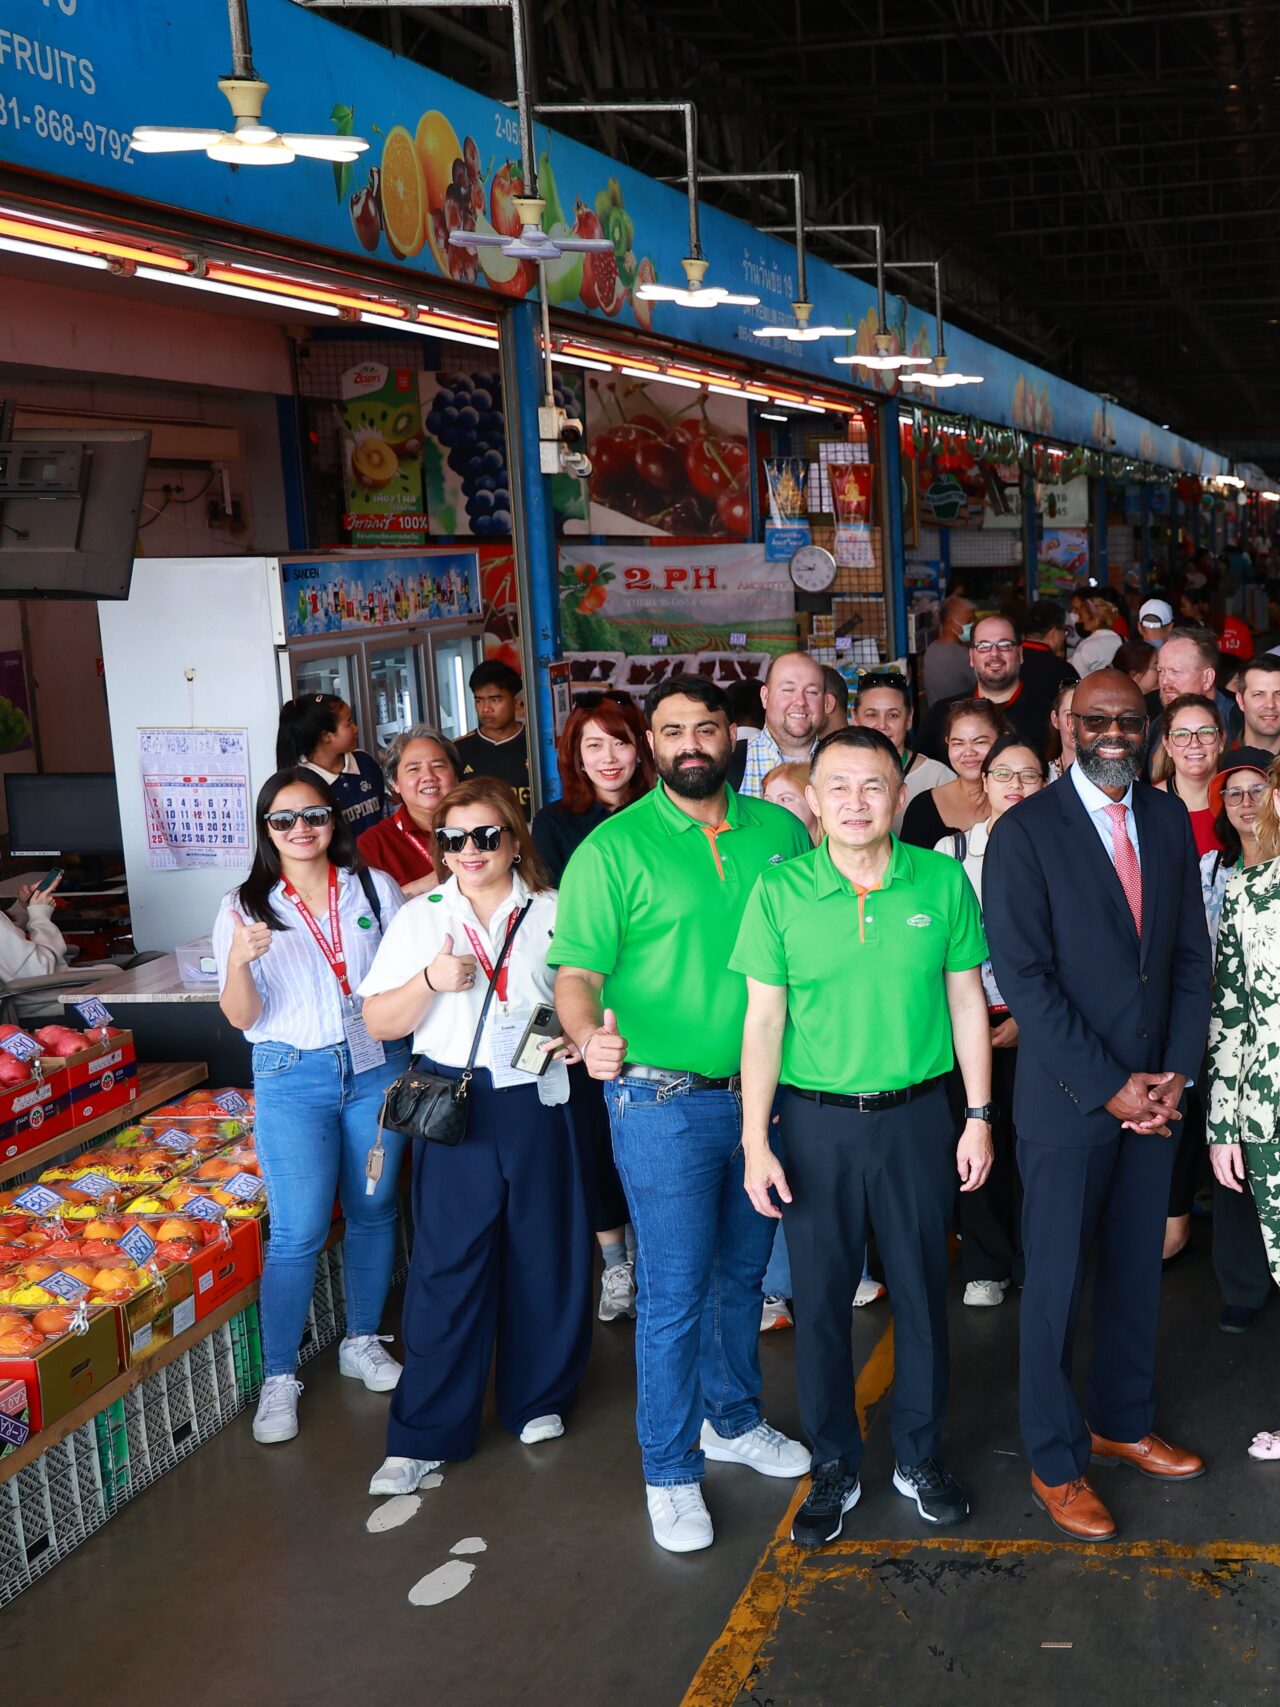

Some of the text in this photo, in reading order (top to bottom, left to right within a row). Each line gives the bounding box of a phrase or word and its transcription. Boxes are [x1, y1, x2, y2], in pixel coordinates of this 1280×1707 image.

[0, 29, 96, 95] FRUITS
[495, 113, 521, 145] 2-05
[399, 515, 428, 530] 100%
[293, 568, 319, 580] SANDEN
[83, 1004, 106, 1022] 290
[8, 1038, 36, 1056] 290
[130, 1235, 154, 1260] 360
[50, 1274, 80, 1296] 250
